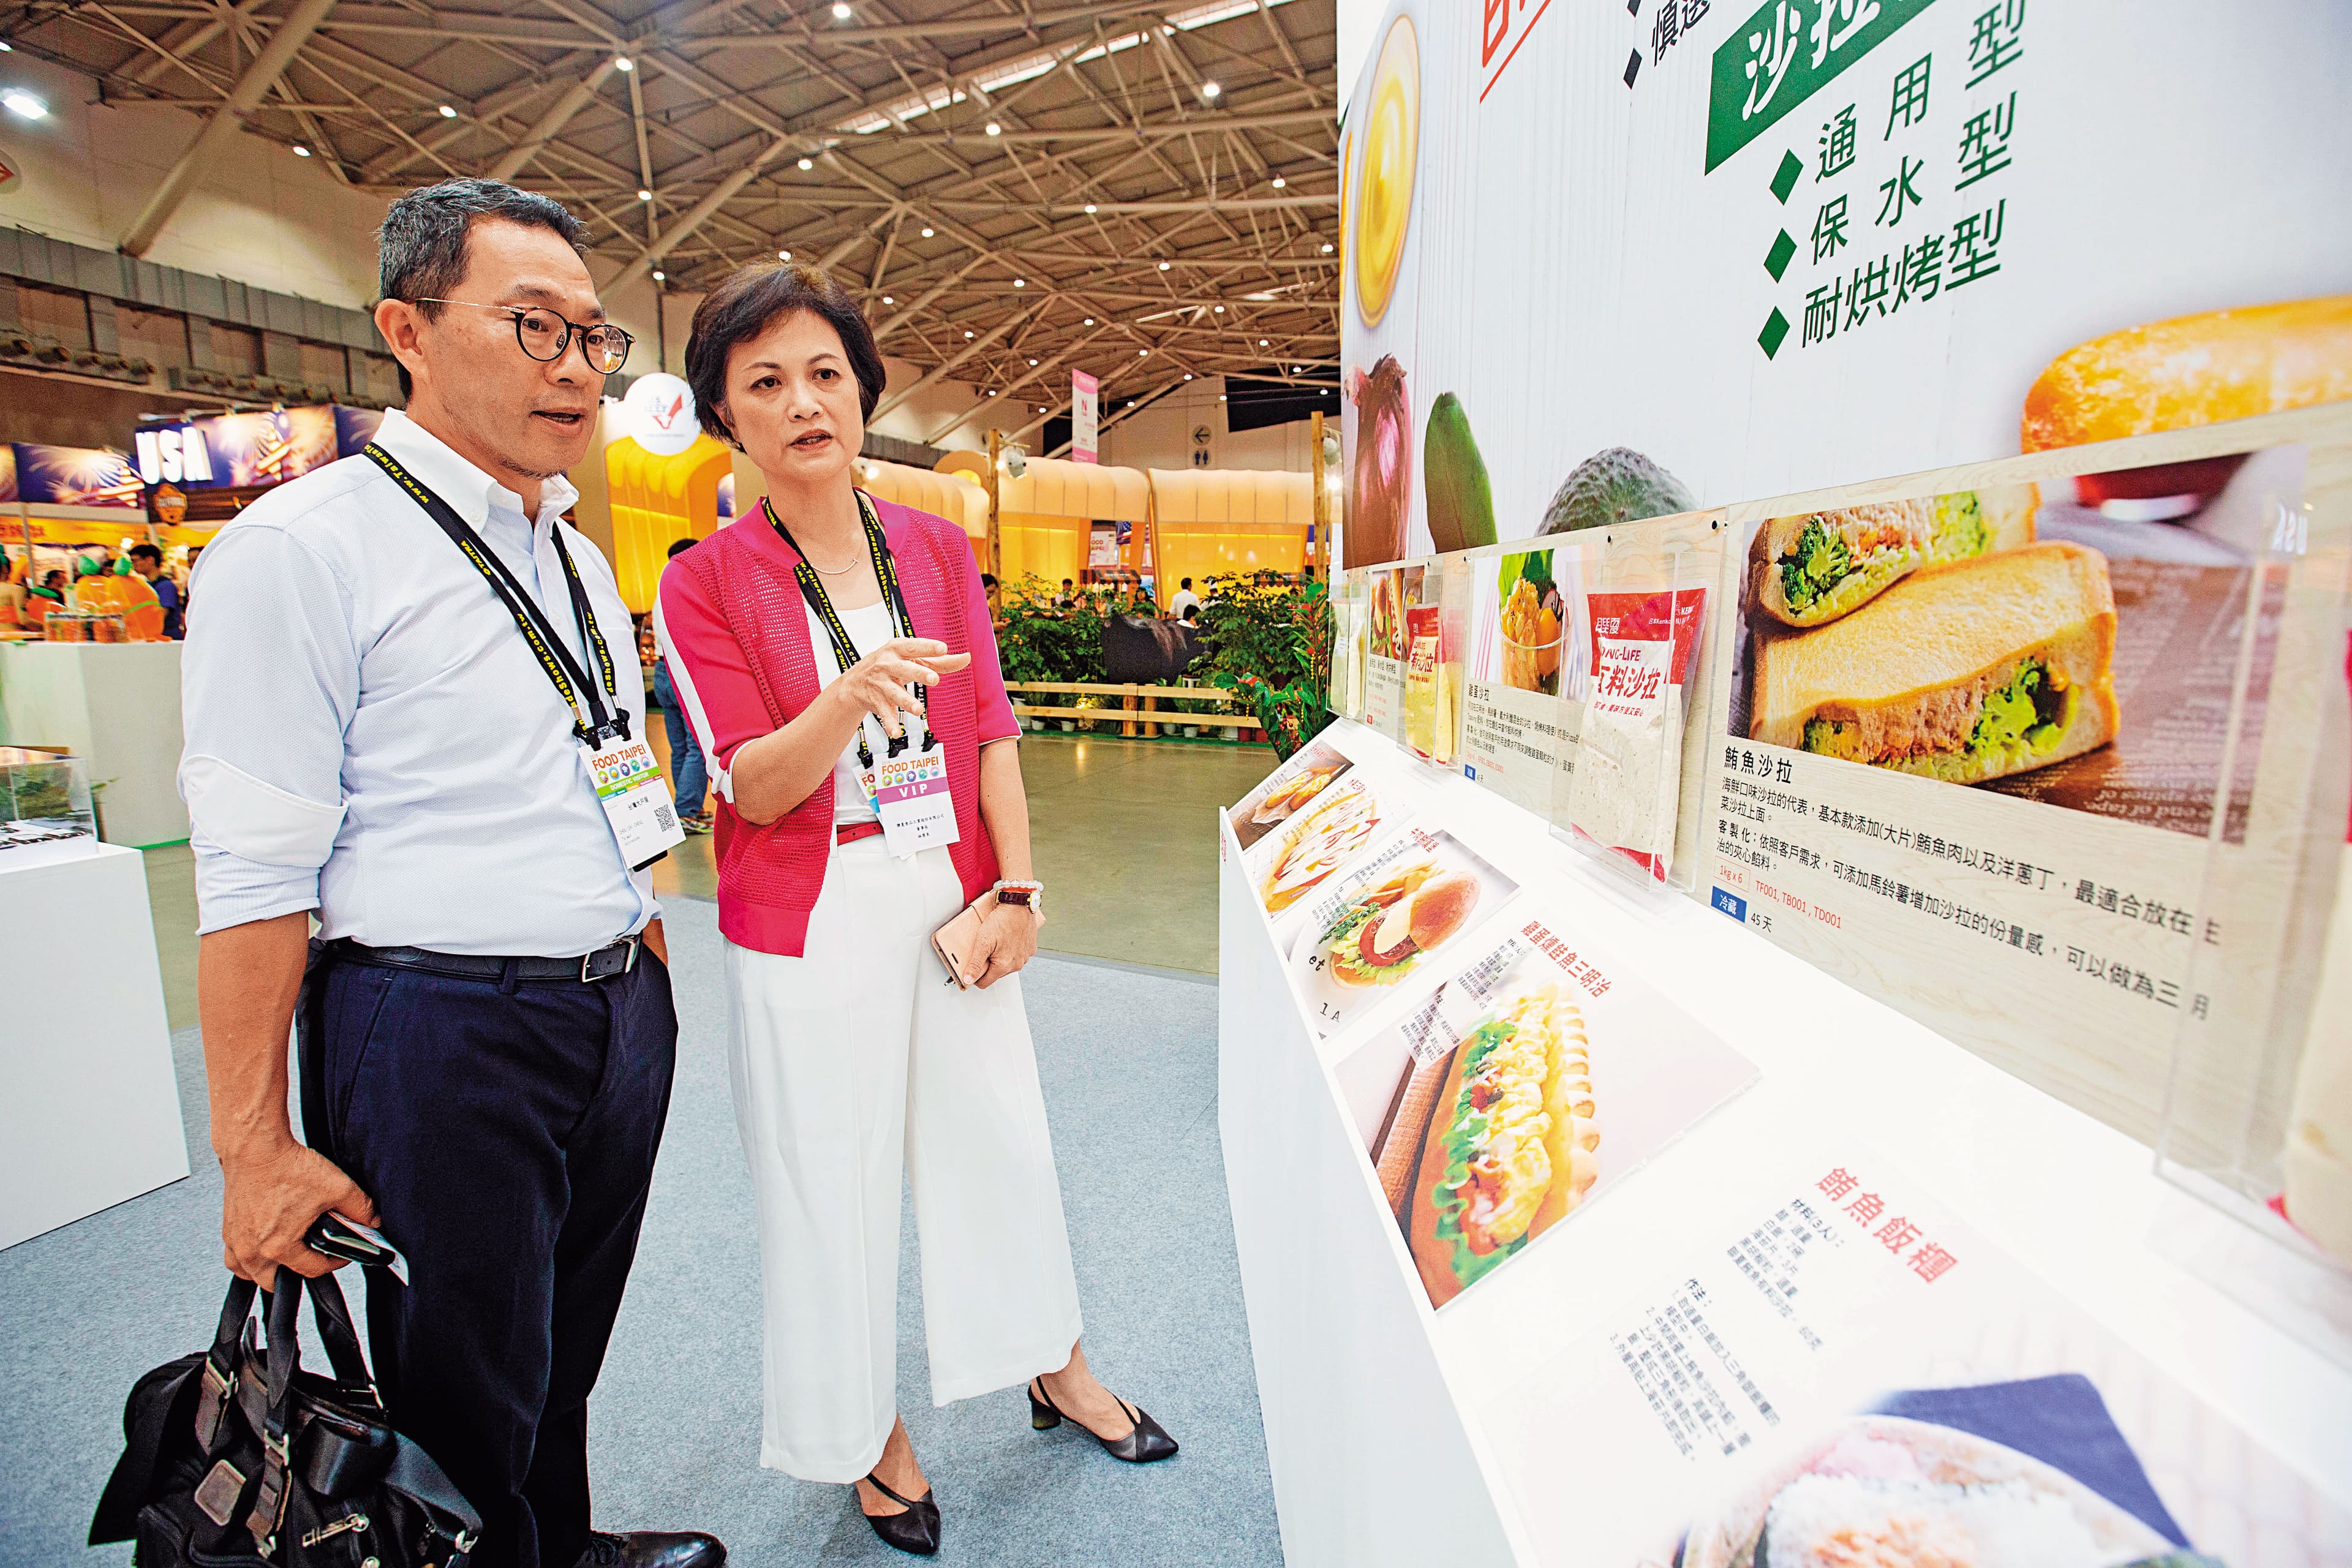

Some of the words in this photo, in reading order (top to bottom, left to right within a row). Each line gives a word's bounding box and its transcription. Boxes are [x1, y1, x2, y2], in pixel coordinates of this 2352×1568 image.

[1815, 0, 2024, 183] 通用型
[1811, 91, 2018, 265] 保水型
[1801, 198, 2007, 348] 耐烘烤型
[135, 427, 213, 484] USA
[800, 562, 857, 663] w.TaiwanTradeShows.co
[592, 753, 619, 771] FOOD
[618, 744, 646, 761] TAIPEI
[882, 762, 908, 775] FOOD
[910, 756, 939, 769] TAIPEI
[1724, 745, 1792, 784] 鮪魚沙拉
[610, 778, 633, 790] DOMESTIC
[633, 772, 649, 782] VISITOR
[861, 774, 876, 786] FO
[899, 783, 927, 797] VIP
[1720, 865, 1731, 881] 1kg
[1738, 873, 1743, 883] 6
[1719, 894, 1737, 915] 冷藏
[1814, 906, 1841, 929] TD001
[1309, 956, 1325, 971] et
[1520, 921, 1612, 998] 雞蛋燻鮭魚三明治
[1815, 1167, 1958, 1283] 鮪魚飯糰
